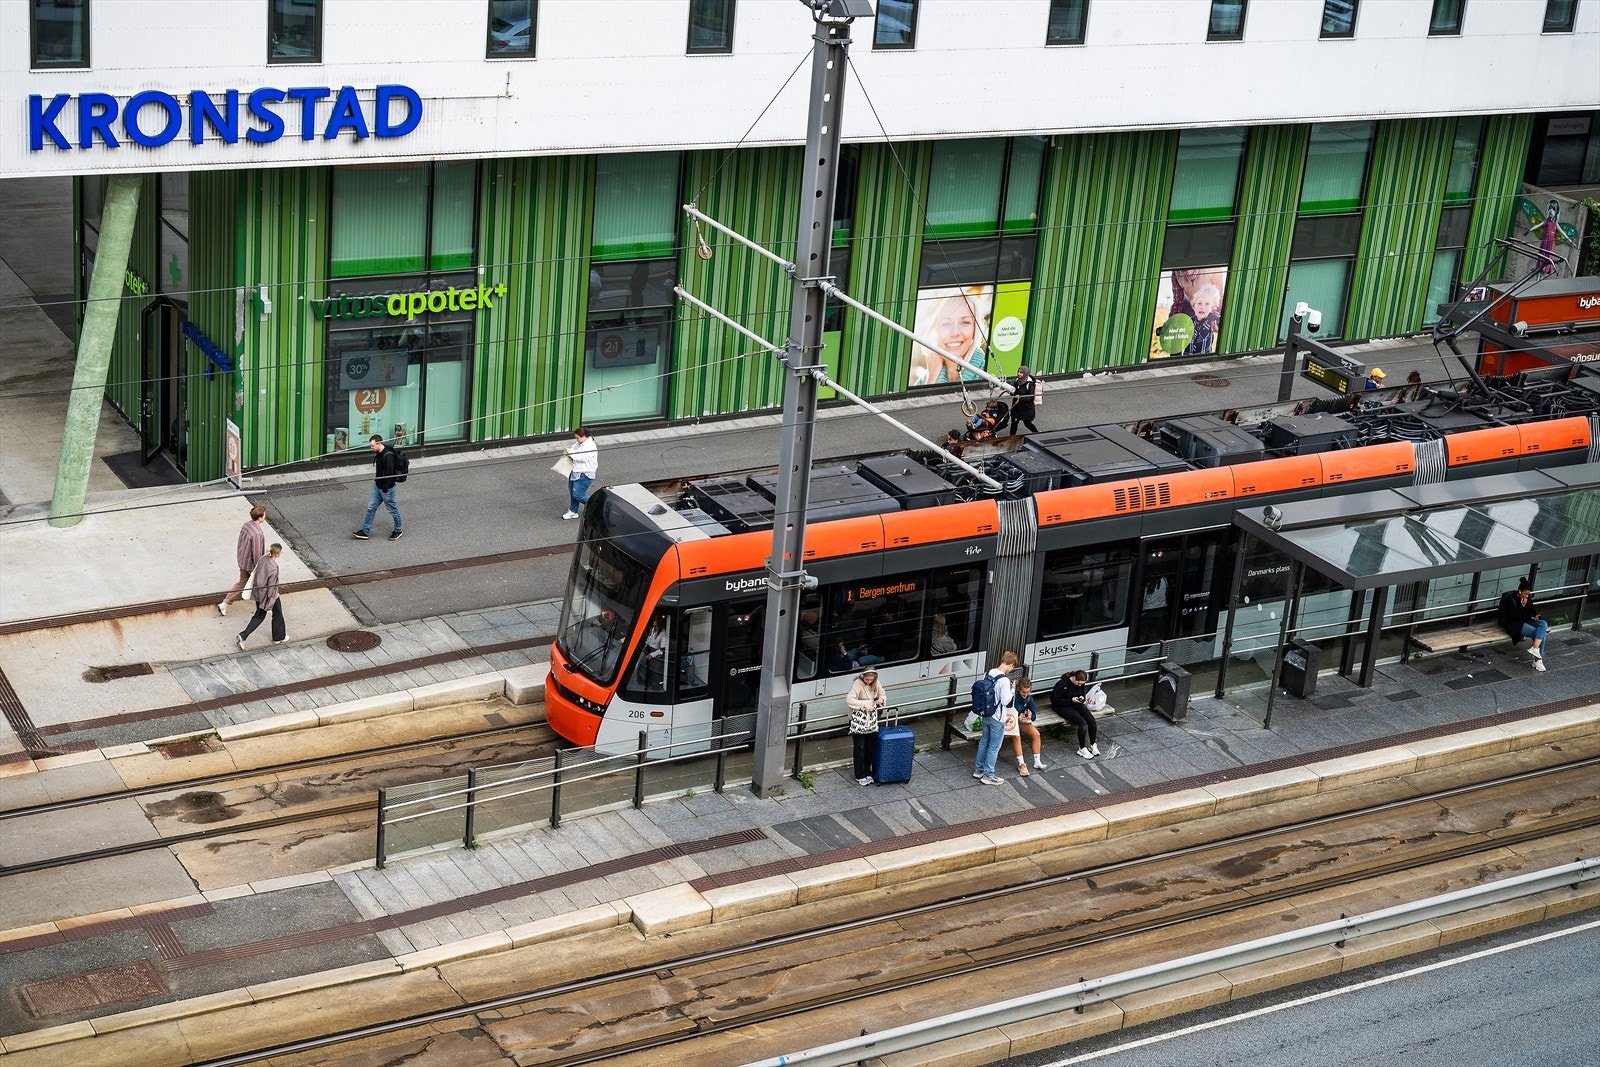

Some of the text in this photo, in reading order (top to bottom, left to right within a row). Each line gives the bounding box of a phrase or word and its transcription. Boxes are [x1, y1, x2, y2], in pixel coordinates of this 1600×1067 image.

[29, 84, 423, 151] KRONSTAD
[310, 283, 494, 321] vitusapotek
[361, 389, 371, 405] 2
[374, 389, 380, 404] 1
[1248, 565, 1290, 577] Danmarks plass
[725, 577, 770, 591] bybane
[847, 582, 915, 601] 1 Bergen sentrum
[1039, 645, 1068, 656] skyss
[628, 710, 645, 719] 206
